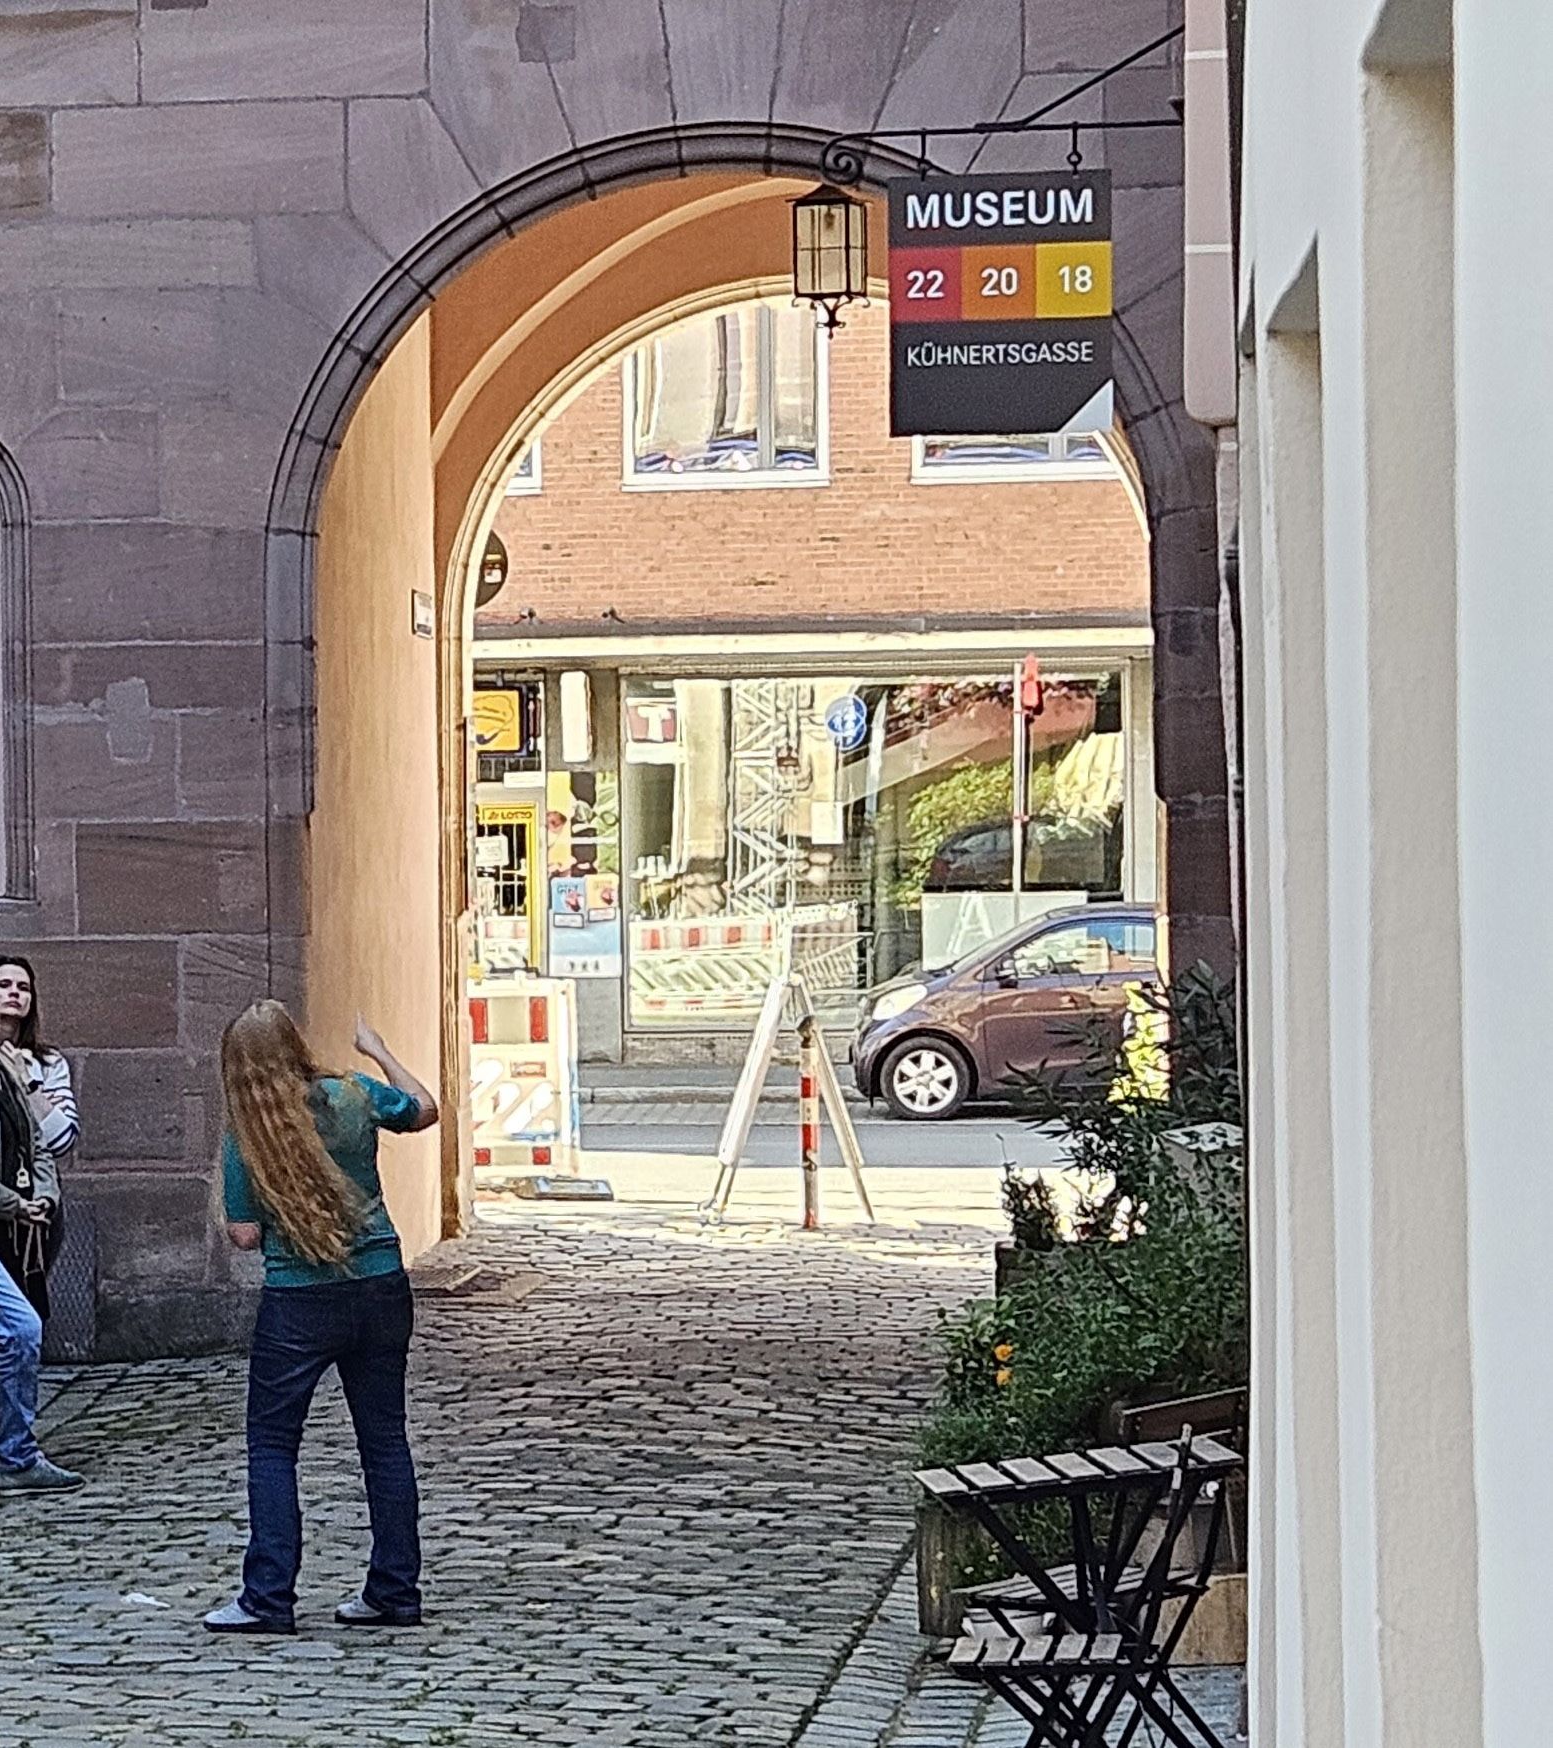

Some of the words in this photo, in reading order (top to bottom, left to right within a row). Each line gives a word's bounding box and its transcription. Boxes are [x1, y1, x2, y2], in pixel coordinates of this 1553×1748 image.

[906, 188, 1094, 229] MUSEUM
[906, 270, 944, 298] 22
[980, 267, 1018, 296] 20
[1058, 265, 1093, 294] 18
[907, 341, 1094, 367] KÜHNERTSGASSE
